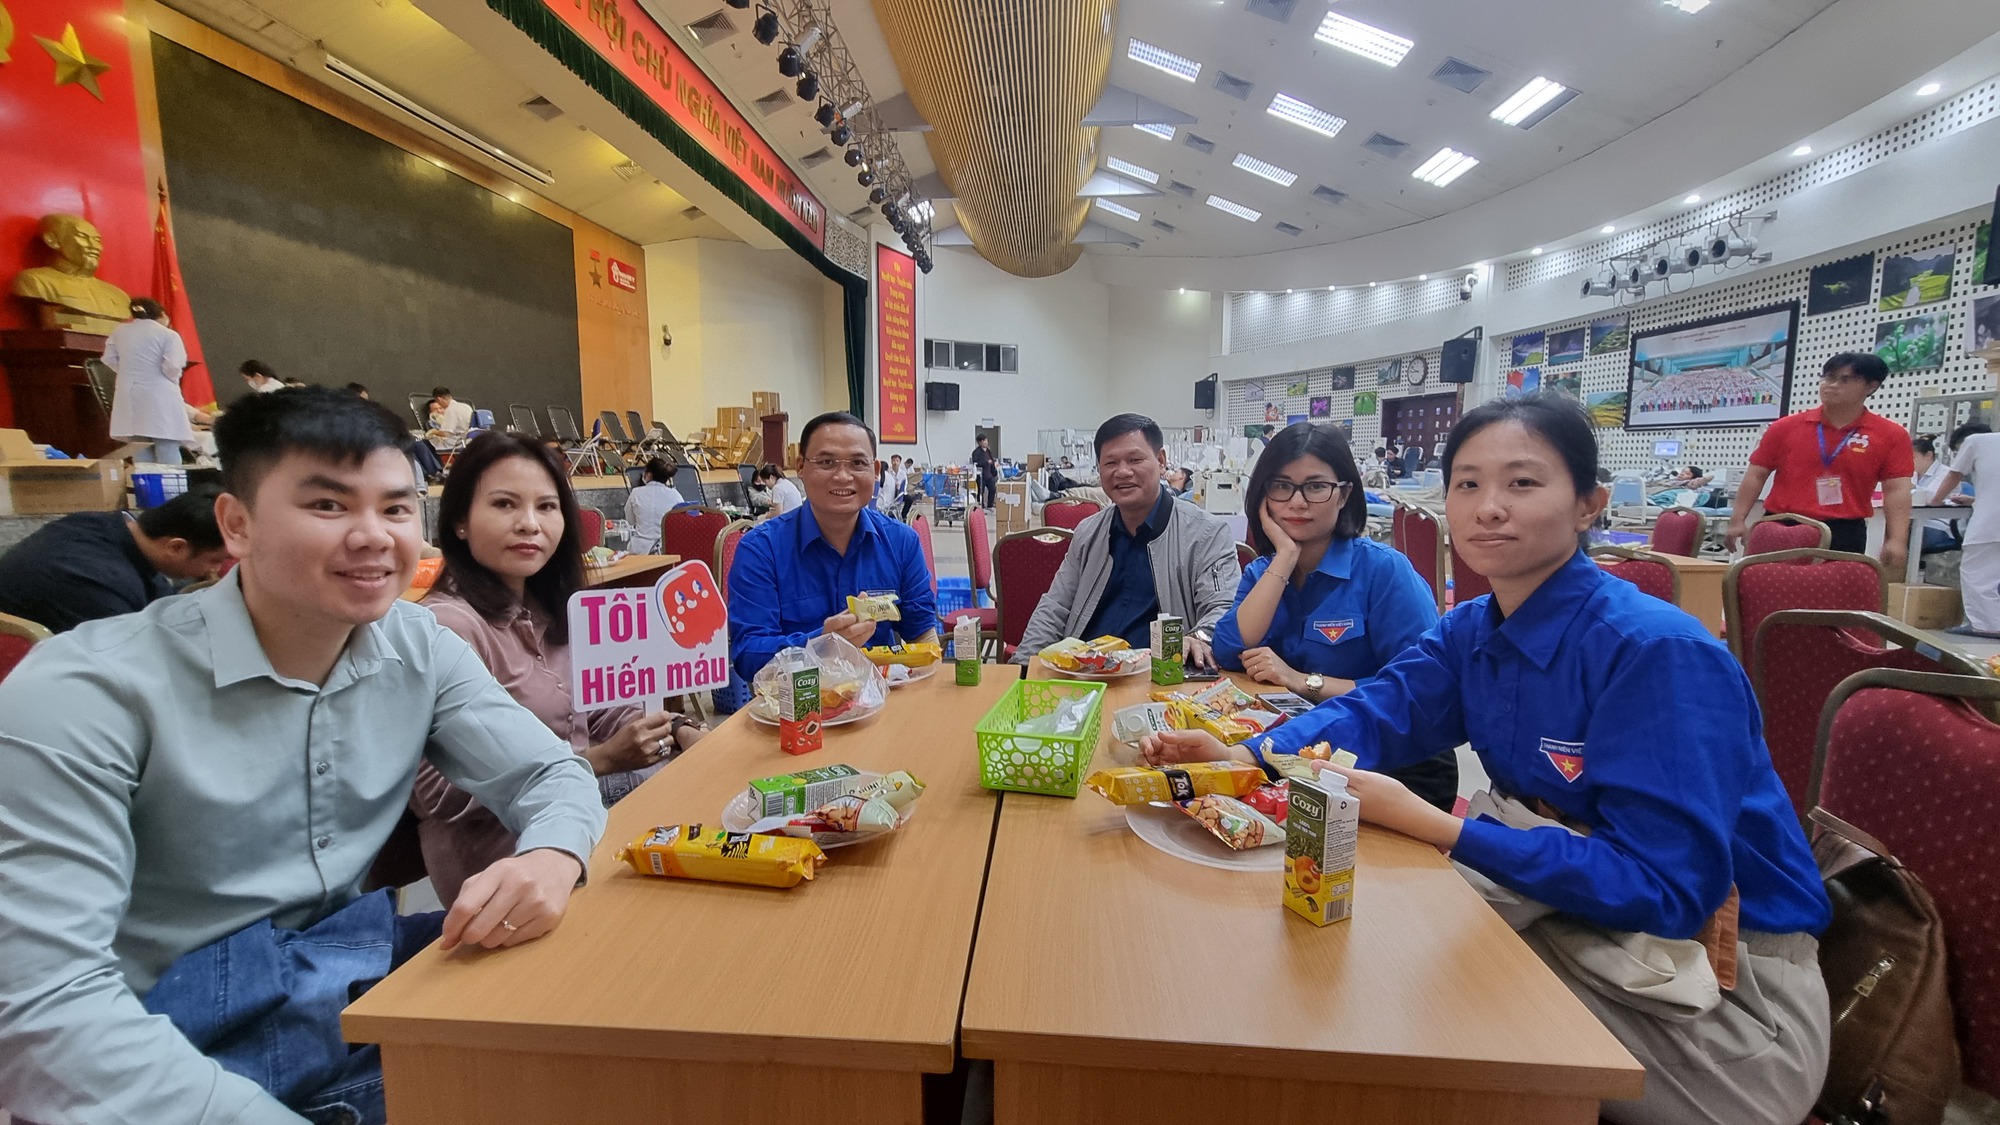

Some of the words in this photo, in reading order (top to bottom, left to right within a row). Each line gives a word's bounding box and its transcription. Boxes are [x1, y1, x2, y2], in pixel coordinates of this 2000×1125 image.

[632, 30, 672, 91] CHỦ
[676, 72, 721, 141] NGHĨA
[723, 120, 749, 166] VIỆT
[751, 149, 774, 191] NAM
[776, 174, 801, 216] MUÔN
[801, 201, 818, 234] NĂM
[580, 593, 648, 645] Tôi
[581, 655, 656, 705] Hiến
[666, 653, 726, 691] máu
[798, 678, 816, 687] Cozy
[1292, 795, 1320, 817] Cozy
